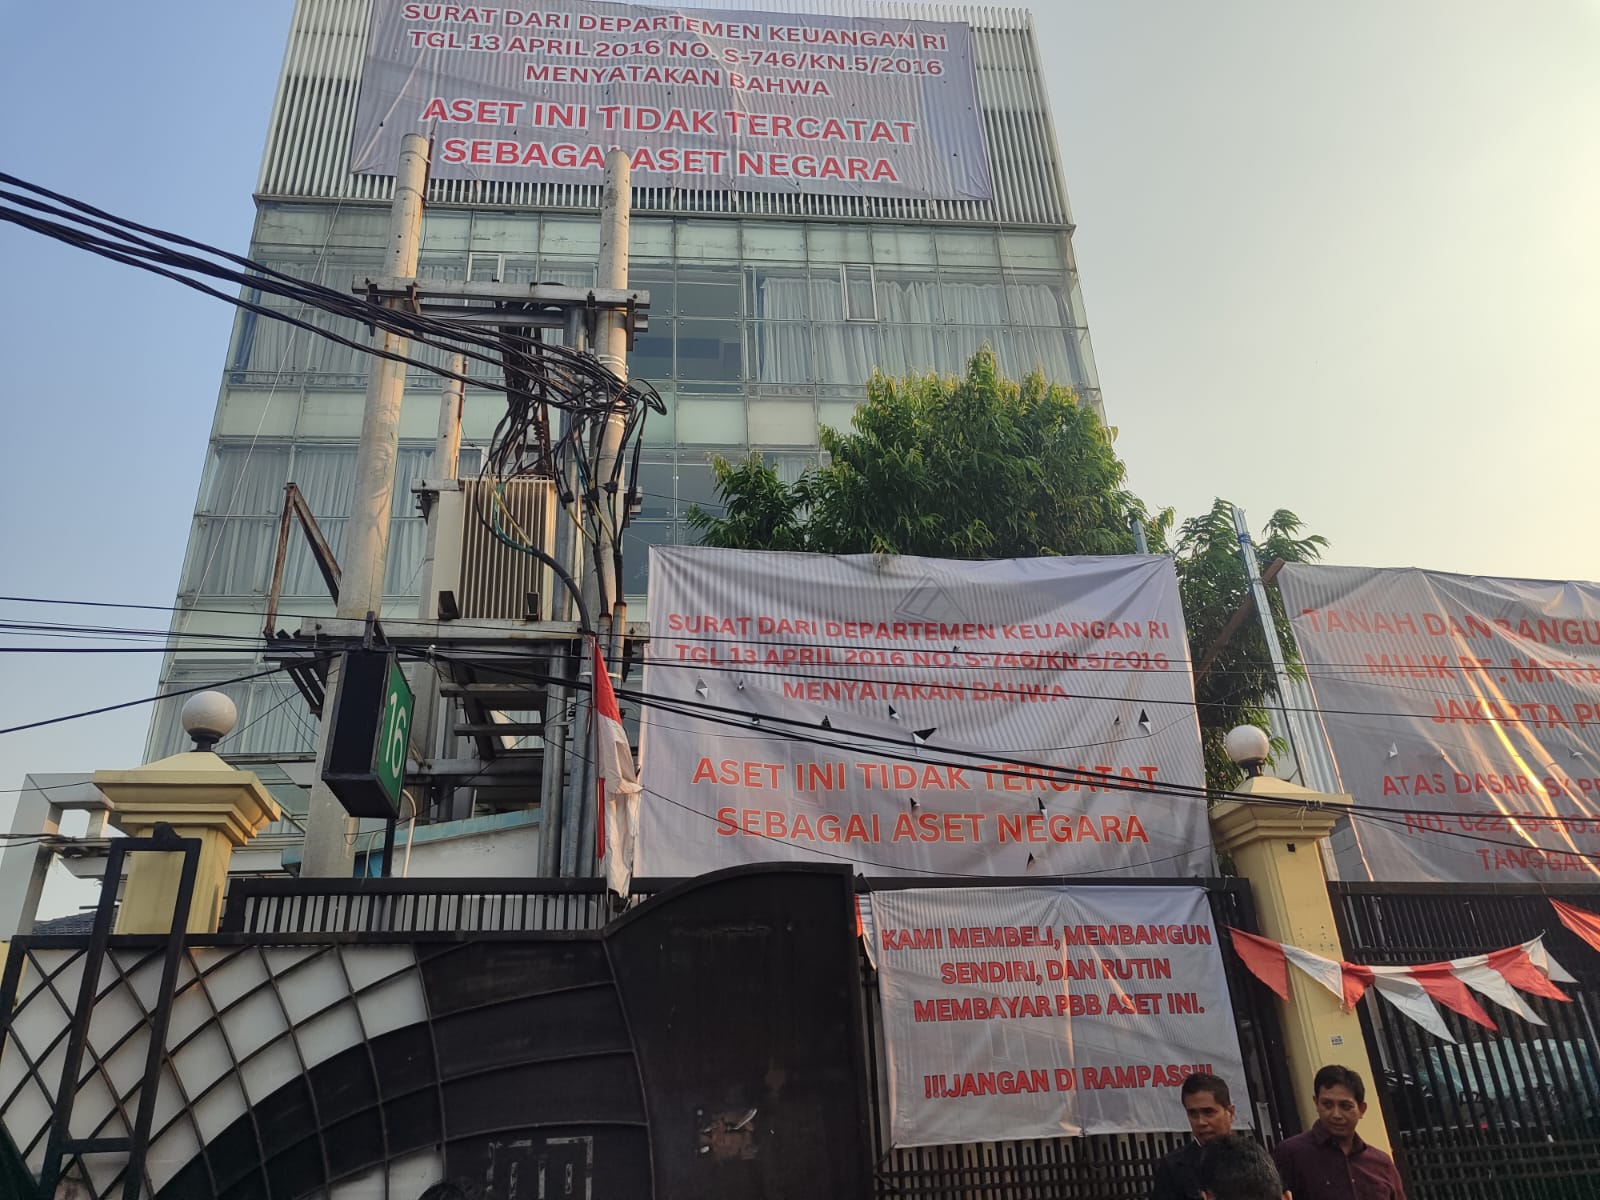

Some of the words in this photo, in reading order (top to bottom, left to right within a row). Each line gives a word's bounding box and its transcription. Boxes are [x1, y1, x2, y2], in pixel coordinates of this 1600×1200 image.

[404, 5, 497, 24] SURAT
[505, 11, 569, 29] DARI
[579, 16, 760, 40] DEPARTEMEN
[769, 26, 915, 49] KEUANGAN
[923, 34, 946, 50] RI
[410, 31, 462, 48] TGL
[469, 34, 500, 51] 13
[507, 37, 588, 56] APRIL
[595, 39, 660, 58] 2016
[669, 40, 718, 59] NO.
[724, 48, 943, 75] S-746/KN.5/2016
[525, 64, 720, 87] MENYATAKAN
[730, 72, 830, 96] BAHWA
[424, 98, 524, 125] ASET
[535, 104, 588, 128] INI
[597, 106, 716, 133] TIDAK
[725, 112, 915, 143] TERCATAT
[442, 138, 619, 168] SEBAGA
[631, 149, 727, 173] ASET
[739, 153, 898, 181] NEGARA
[668, 613, 752, 635] SURAT
[757, 616, 817, 636] DARI
[825, 621, 994, 641] DEPARTEMEN
[1003, 621, 1142, 640] KEUANGAN
[1148, 620, 1170, 639] RI
[1302, 608, 1418, 636] TANAH
[1422, 612, 1493, 639] DAN
[674, 643, 724, 666] TGL
[729, 647, 757, 666] 13
[763, 648, 839, 667] APRIL
[845, 649, 905, 667] 2016
[965, 650, 1170, 671] S-746/KN.5/2016
[1364, 652, 1457, 680] MILIK
[783, 681, 965, 701] MENYATAKAN
[972, 681, 1070, 703] BAHWA
[1575, 703, 1600, 728] P
[385, 691, 407, 779] 16
[691, 758, 785, 788] ASET
[796, 761, 846, 791] INI
[856, 763, 971, 791] TIDAK
[978, 764, 1159, 793] TERCATAT
[1383, 773, 1446, 797] ATAS
[1454, 773, 1533, 795] DASAR
[716, 807, 881, 843] SEBAGAI
[893, 814, 986, 843] ASET
[997, 814, 1149, 843] NEGARA
[881, 928, 943, 951] KAMI
[948, 926, 1060, 951] MEMBELI,
[1065, 924, 1212, 946] MEMBANGUN
[941, 960, 1043, 986] SENDIRI,
[1047, 959, 1097, 983] DAN
[1103, 957, 1171, 980] RUTIN
[914, 995, 1051, 1023] MEMBAYAR
[1056, 993, 1101, 1018] PBB
[1107, 992, 1162, 1016] ASET
[1168, 991, 1205, 1015] INI.
[924, 1070, 1050, 1099] !!!JANGAN
[1055, 1069, 1078, 1092] DI
